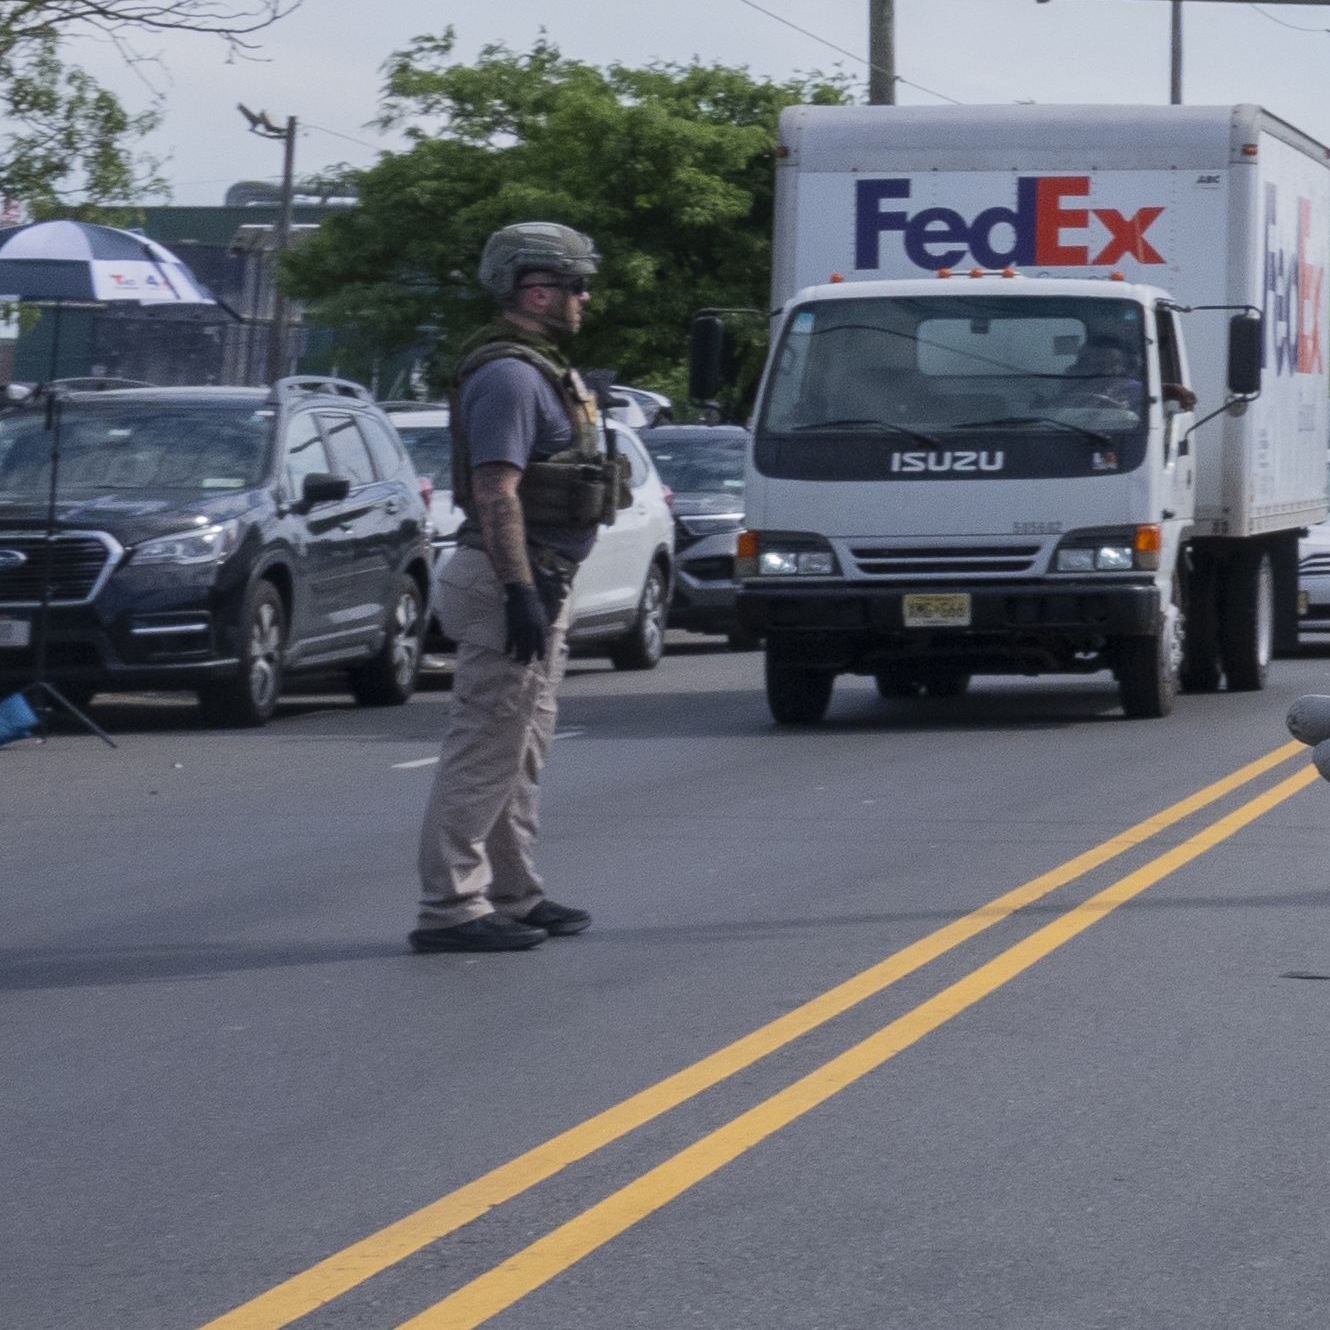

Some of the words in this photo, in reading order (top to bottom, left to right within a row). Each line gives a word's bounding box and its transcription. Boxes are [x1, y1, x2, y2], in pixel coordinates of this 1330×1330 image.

[855, 176, 1167, 271] FedEx
[1259, 181, 1324, 376] FedEx
[892, 451, 1004, 472] ISUZU
